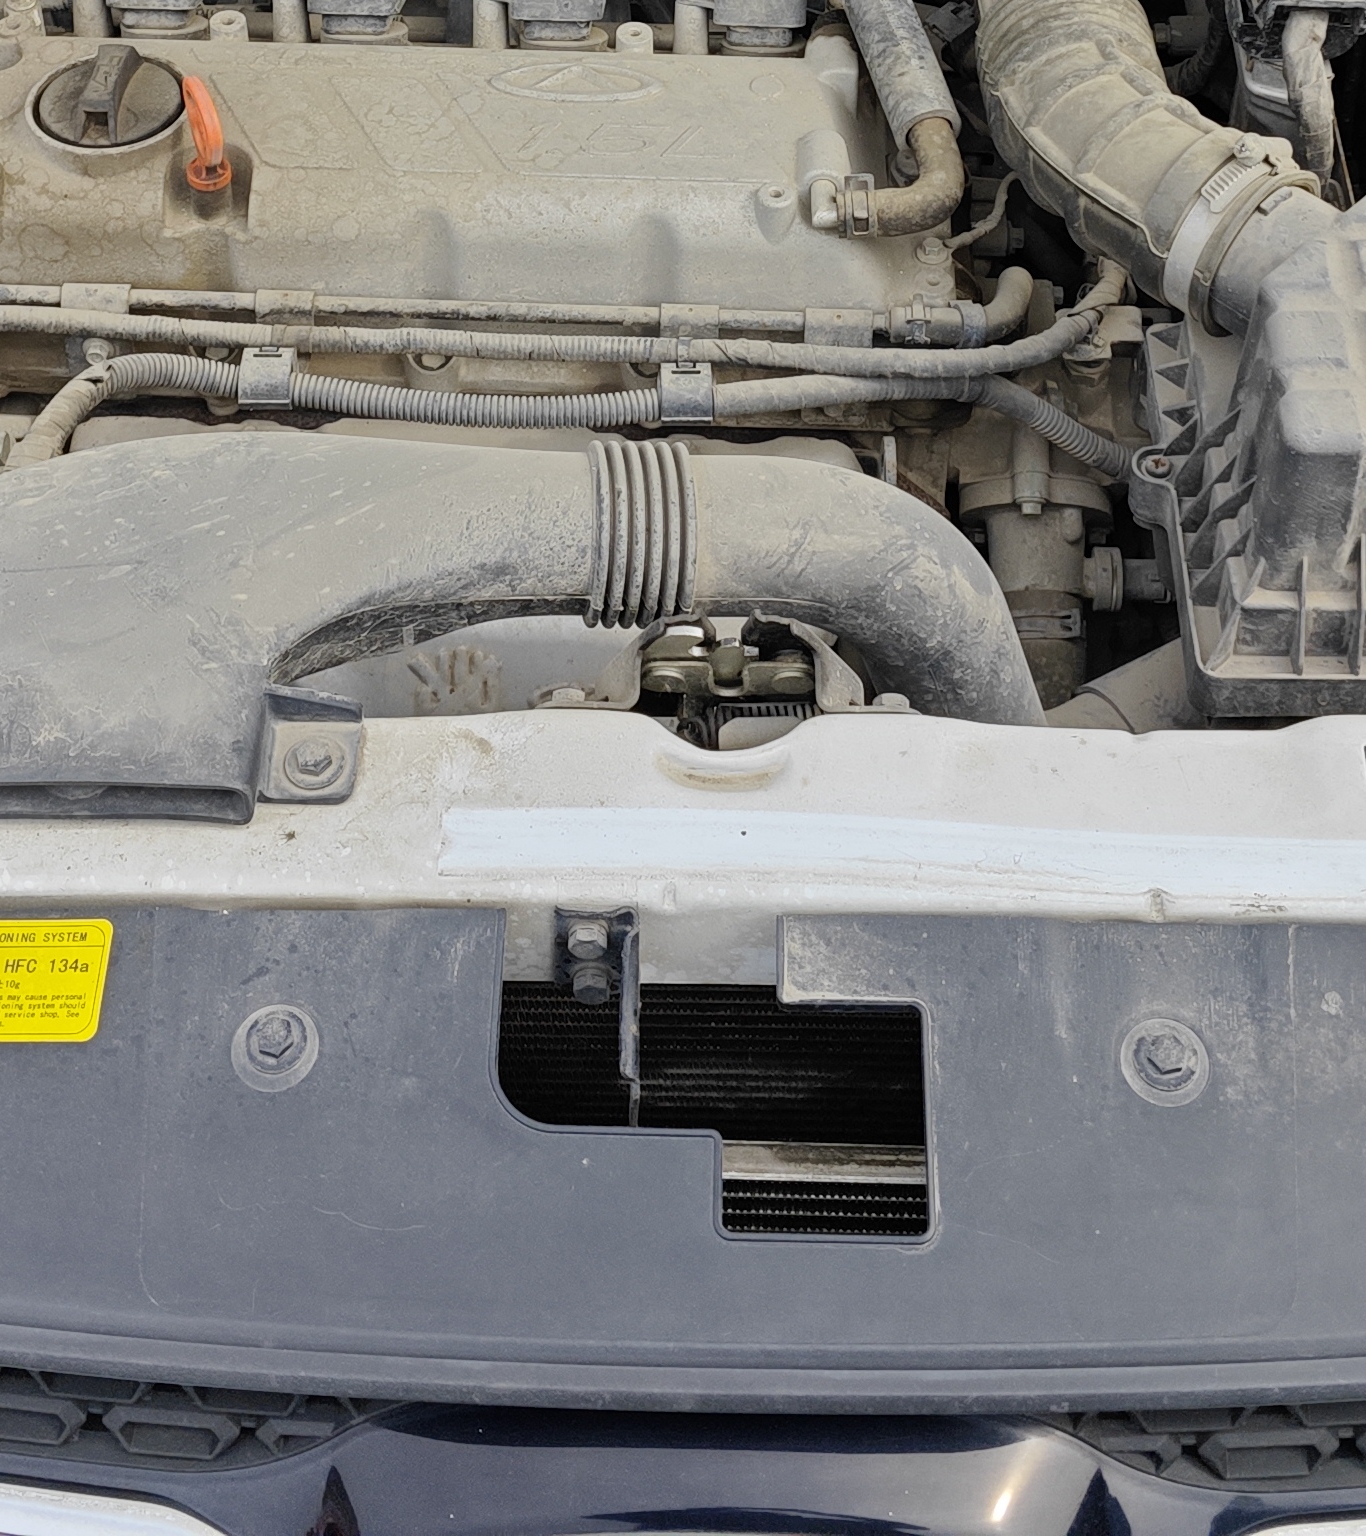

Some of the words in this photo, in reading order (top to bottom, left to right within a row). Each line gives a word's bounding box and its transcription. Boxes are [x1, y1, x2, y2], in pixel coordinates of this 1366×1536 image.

[43, 932, 88, 942] SYSTEM
[4, 959, 38, 973] HFC
[49, 958, 89, 973] 134a
[8, 994, 21, 1002] may
[51, 993, 86, 1002] personal
[59, 1001, 86, 1010] should
[66, 1010, 80, 1018] See
